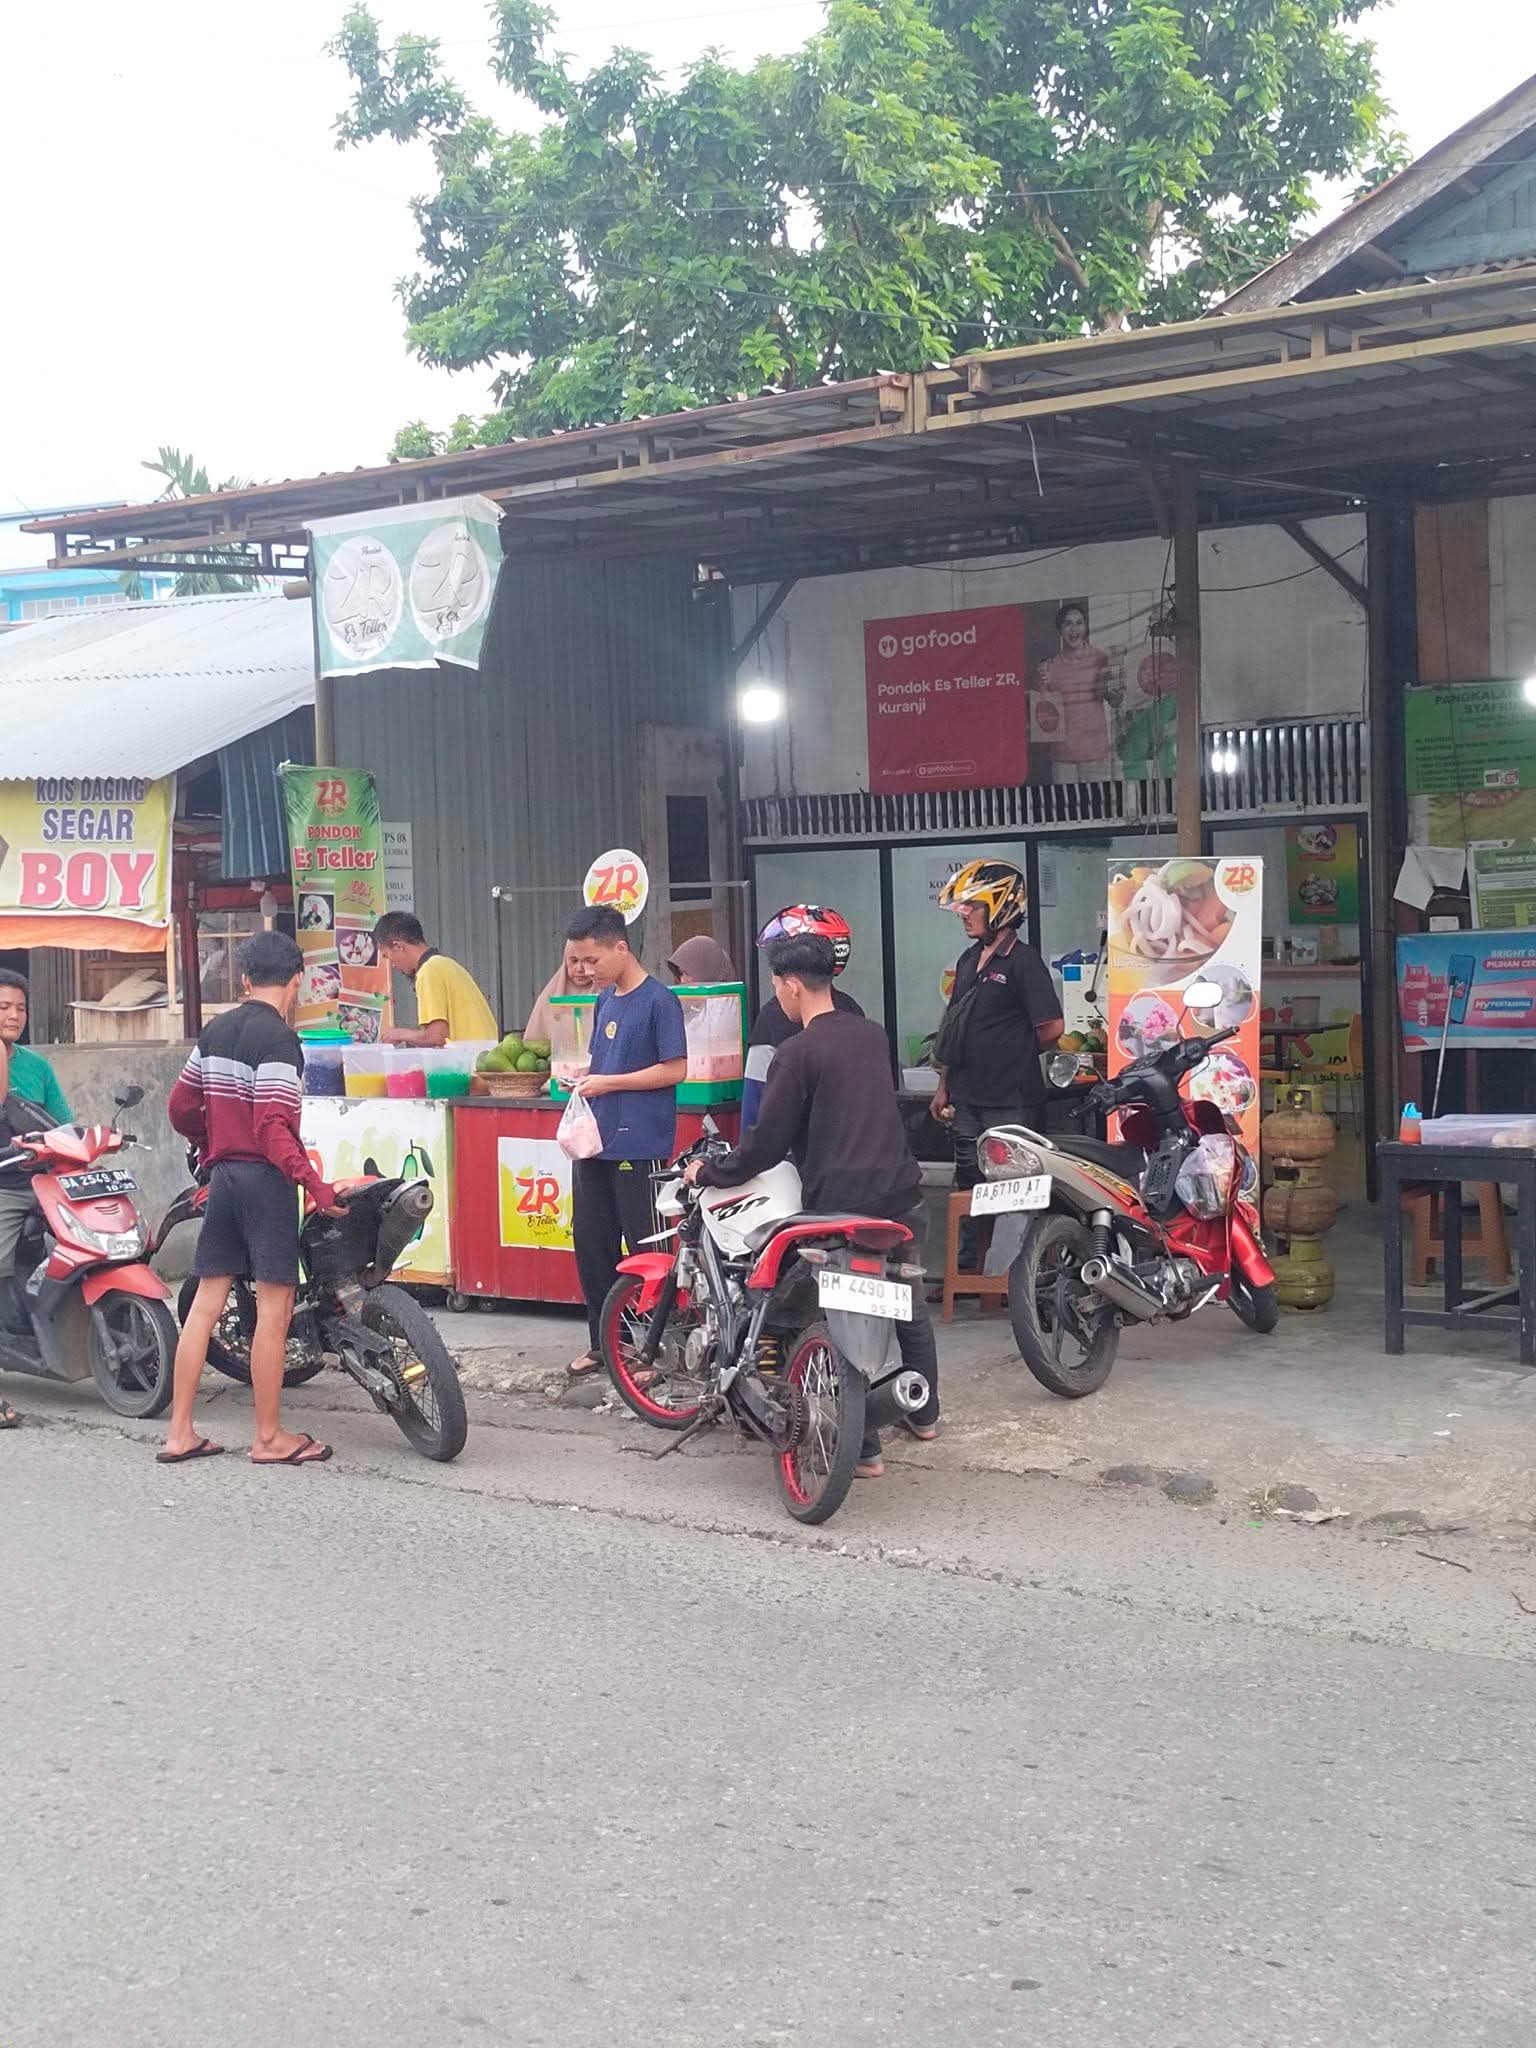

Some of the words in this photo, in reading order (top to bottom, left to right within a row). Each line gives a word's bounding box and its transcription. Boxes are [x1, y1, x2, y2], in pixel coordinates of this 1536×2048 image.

[901, 625, 977, 656] gofood
[877, 679, 931, 697] Pondok
[934, 678, 952, 692] Es
[953, 675, 993, 690] Teller
[995, 672, 1021, 687] ZR,
[878, 697, 927, 715] Kuranji
[80, 778, 145, 802] DAGING
[315, 779, 348, 807] ZR
[42, 808, 135, 841] SEGAR
[316, 846, 376, 869] Teller
[19, 851, 156, 908] BOY
[591, 863, 640, 904] ZR
[1223, 866, 1256, 887] ZR
[1490, 948, 1525, 960] BRIGHT
[80, 1172, 111, 1186] 2549
[975, 1185, 989, 1200] BA
[992, 1181, 1021, 1197] 6710
[1027, 1179, 1041, 1192] AT
[515, 1176, 561, 1215] ZR
[536, 1214, 558, 1226] Teller
[821, 1273, 841, 1291] BM
[848, 1279, 885, 1299] 4490
[894, 1285, 909, 1304] IK
